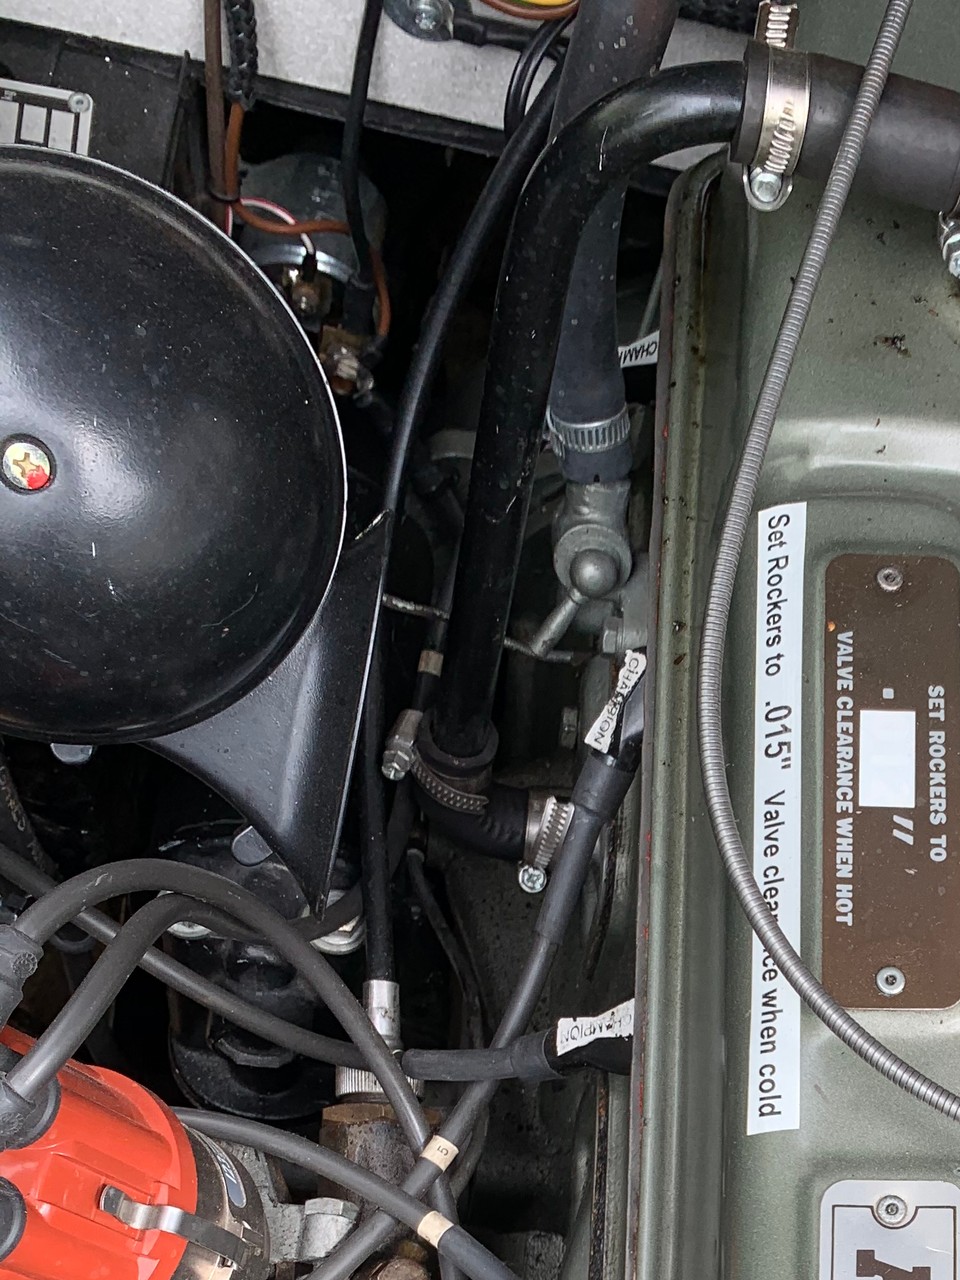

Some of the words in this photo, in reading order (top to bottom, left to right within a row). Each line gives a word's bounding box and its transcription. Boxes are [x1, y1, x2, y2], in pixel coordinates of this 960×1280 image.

[620, 341, 658, 365] CHAM
[767, 513, 791, 552] Set
[766, 555, 788, 648] Rockers
[765, 653, 785, 677] to
[836, 631, 854, 691] VALVE
[928, 685, 945, 722] SET
[836, 696, 854, 813] CLEARANCE
[928, 730, 947, 826] ROCKERS
[763, 790, 786, 858] Valve
[836, 818, 854, 878] WHEN
[929, 835, 947, 862] TO
[762, 864, 785, 982] cleace
[836, 884, 854, 927] HOT
[760, 988, 784, 1055] when
[759, 1064, 782, 1118] cold
